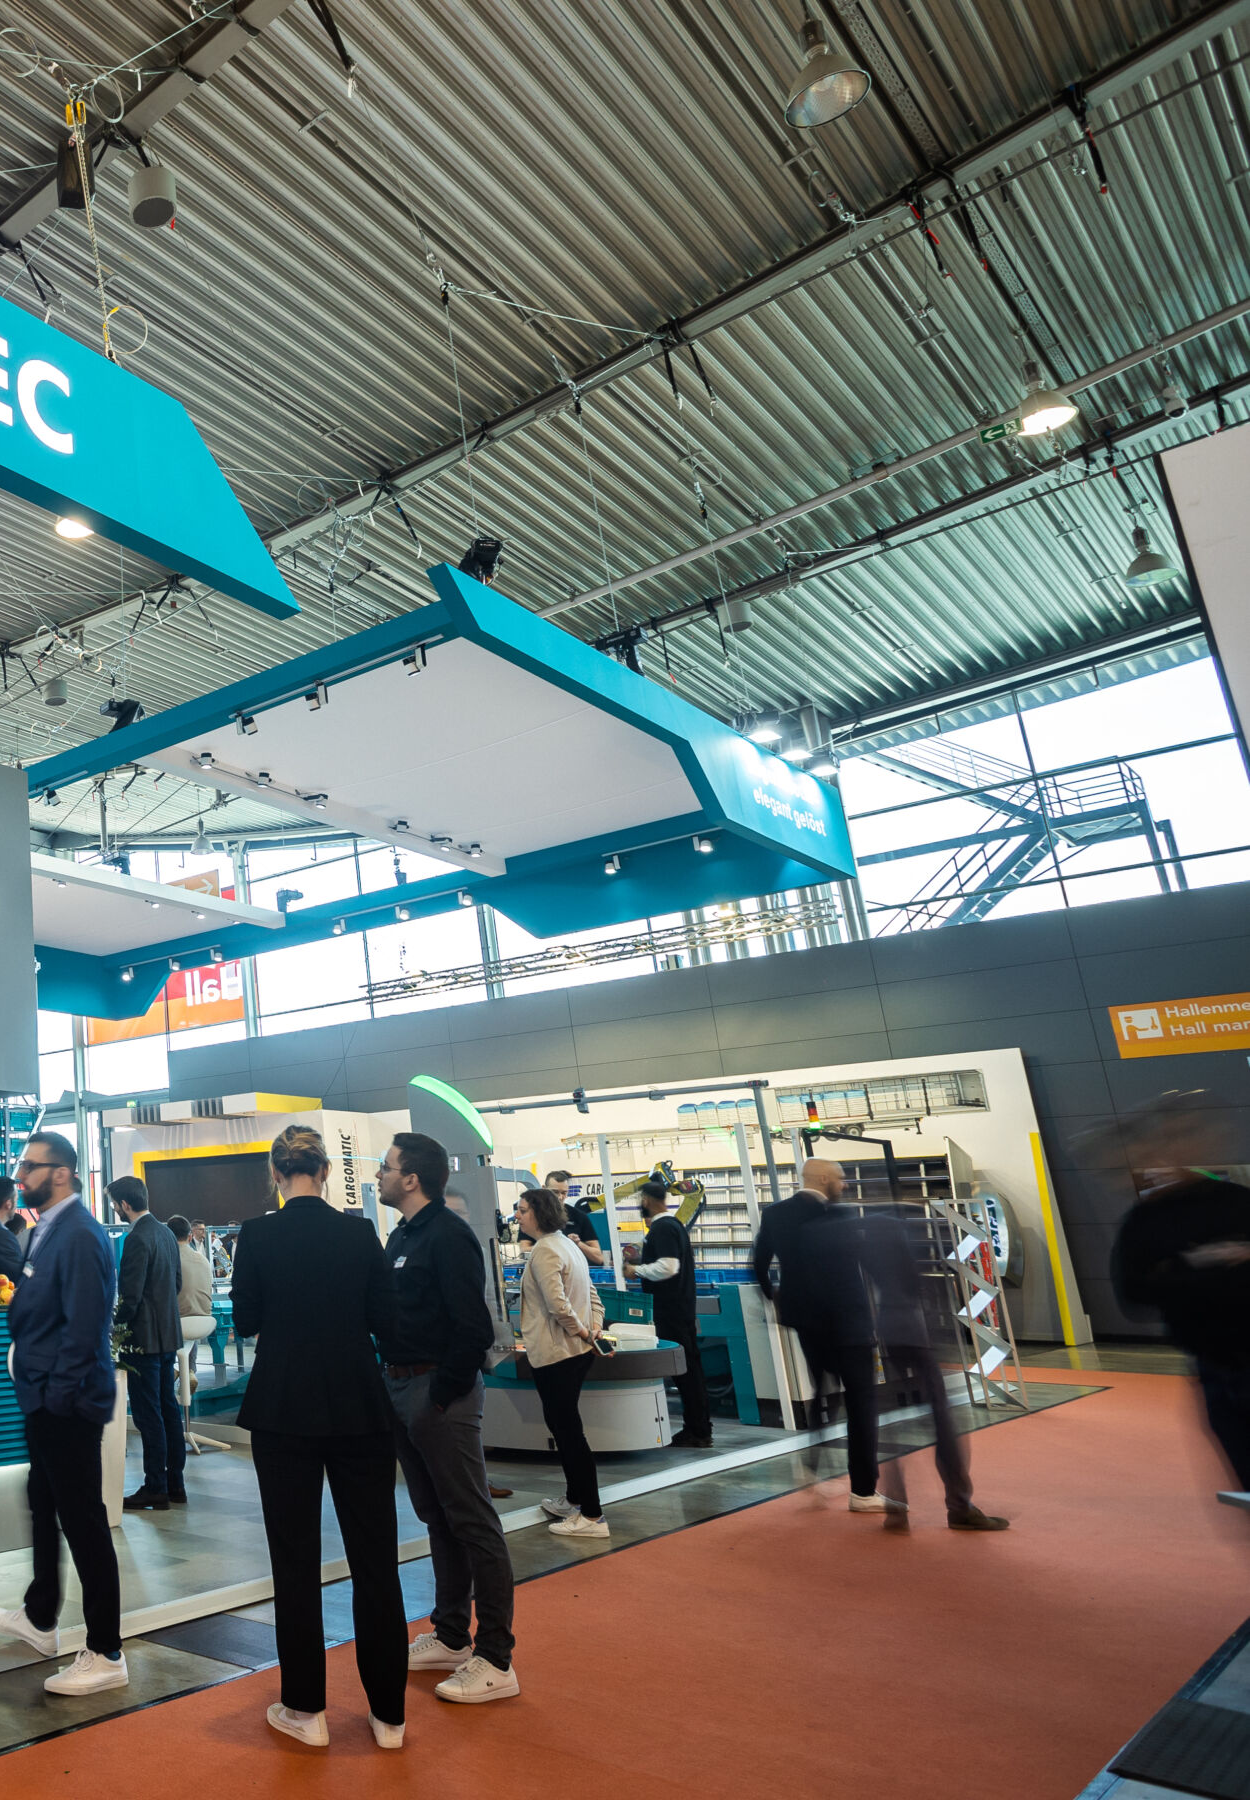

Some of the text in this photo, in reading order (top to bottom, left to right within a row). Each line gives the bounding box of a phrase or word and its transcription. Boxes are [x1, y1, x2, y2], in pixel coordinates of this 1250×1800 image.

[753, 786, 827, 837] elegant gelöst
[1170, 1021, 1206, 1036] Hall
